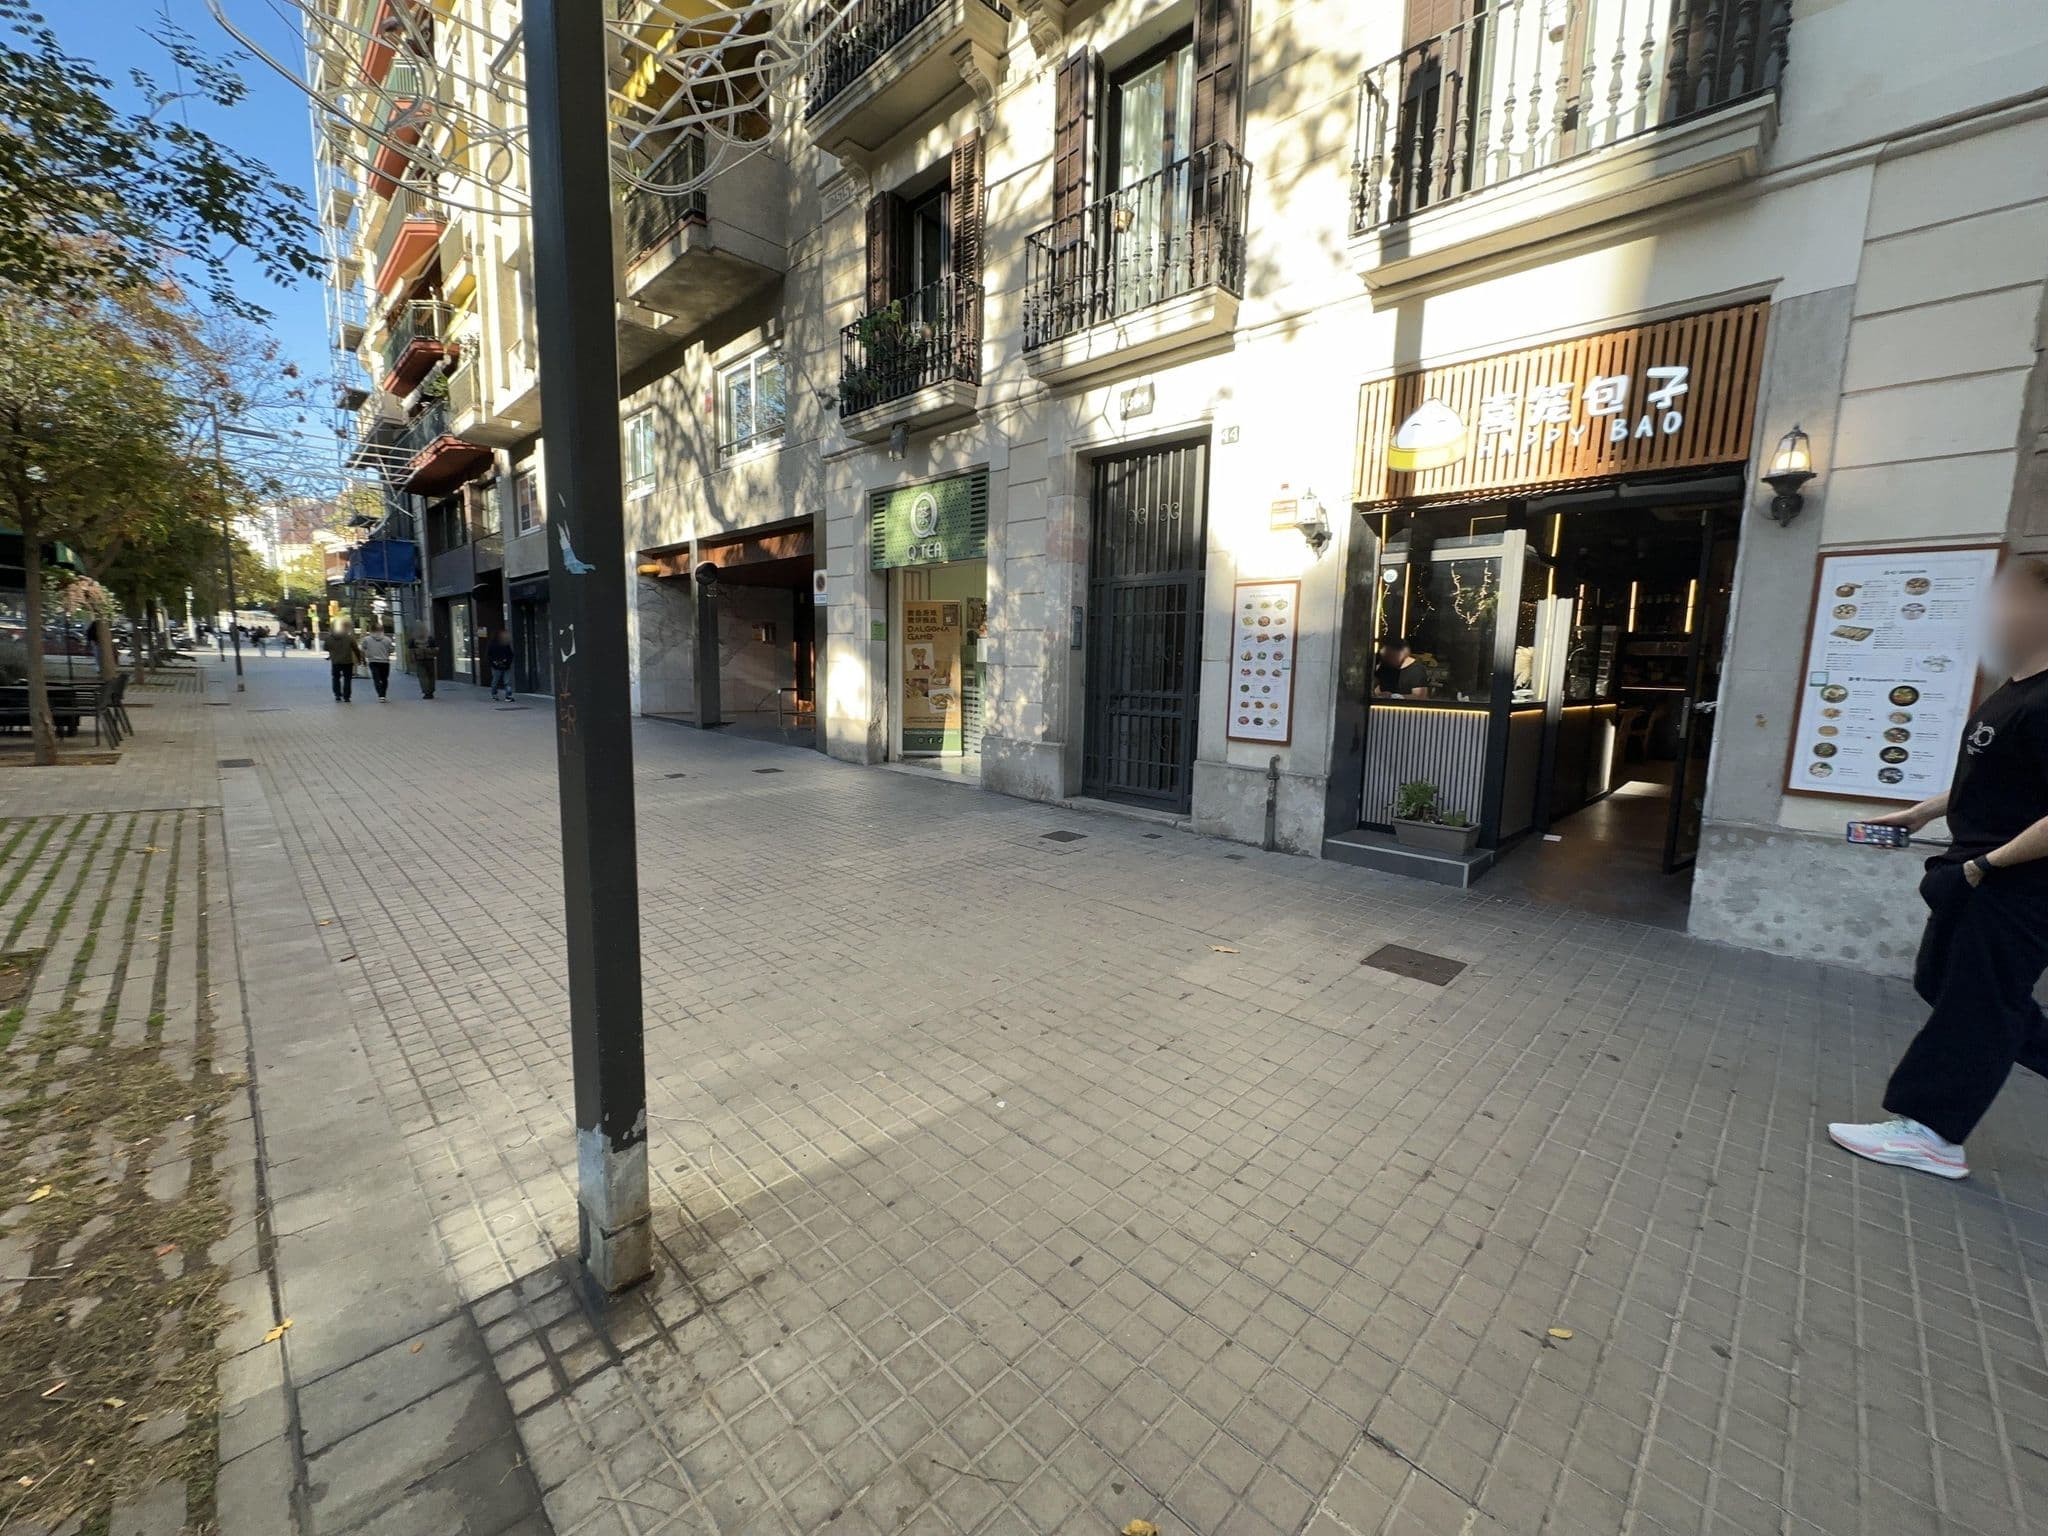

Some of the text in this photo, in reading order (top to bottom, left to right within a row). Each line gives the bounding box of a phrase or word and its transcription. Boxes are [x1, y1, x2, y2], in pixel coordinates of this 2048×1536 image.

[1478, 411, 1683, 460] HAPPY BAO
[907, 541, 942, 561] Q TEA
[907, 625, 950, 633] DALGONA
